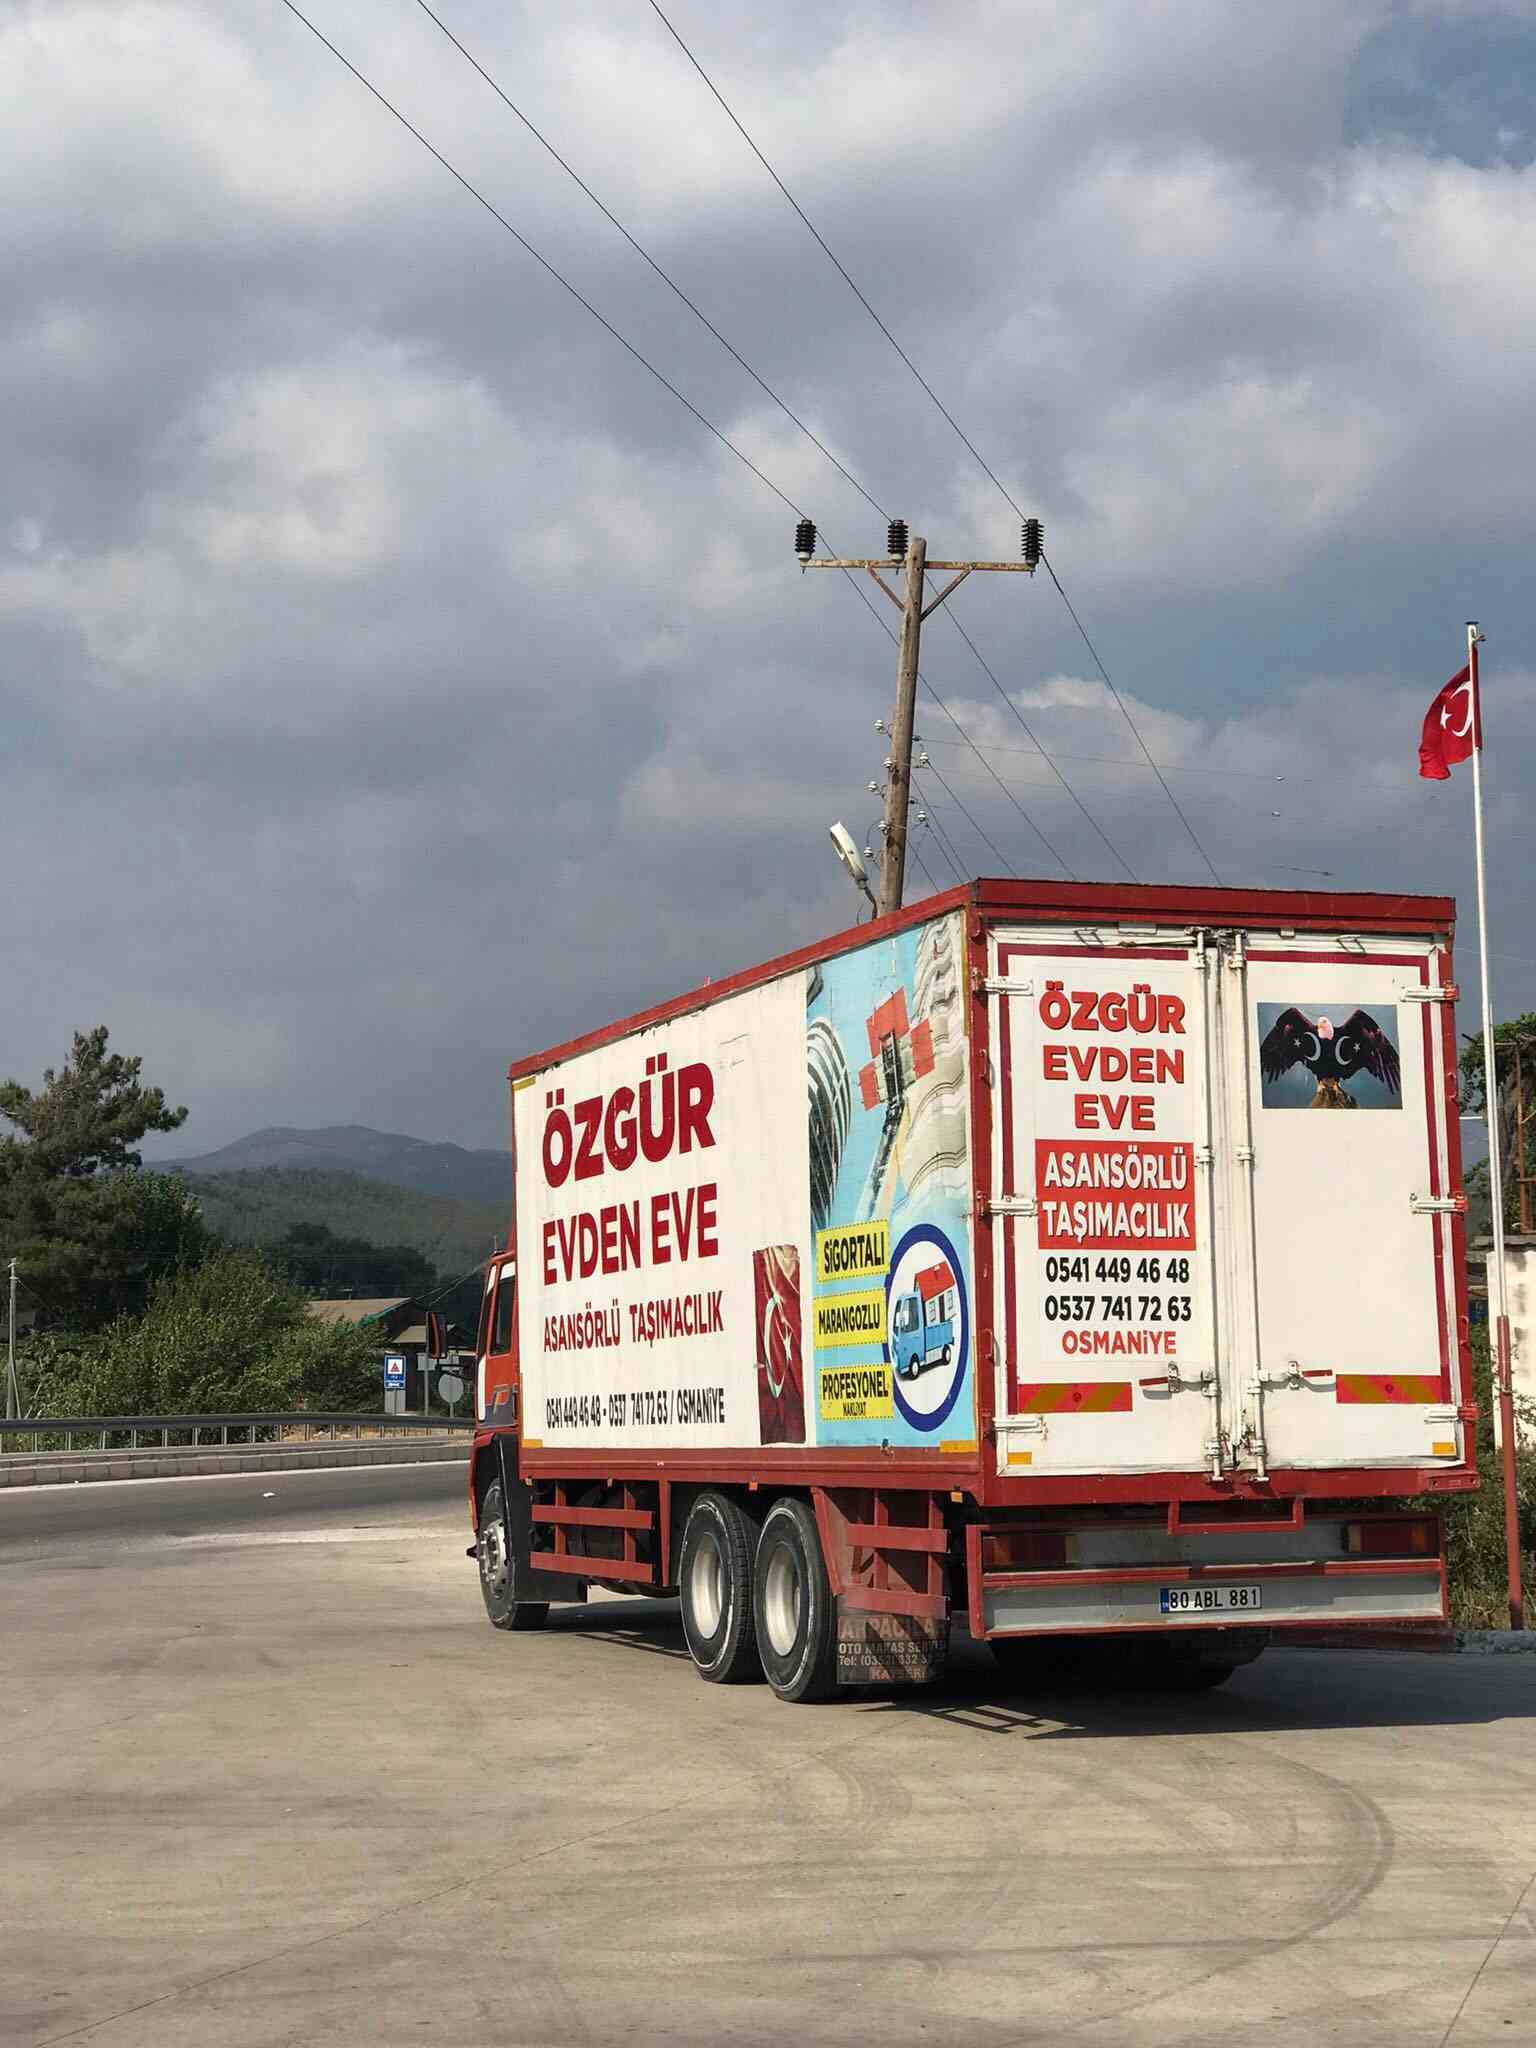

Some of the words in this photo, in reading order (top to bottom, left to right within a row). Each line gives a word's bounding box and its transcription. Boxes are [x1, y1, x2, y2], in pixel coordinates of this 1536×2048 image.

[1039, 980, 1186, 1034] ÖZGÜR
[1043, 1045, 1185, 1084] EVDEN
[542, 1052, 716, 1188] ÖZGÜR
[1074, 1093, 1156, 1130] EVE
[1044, 1145, 1188, 1190] ASANSÖRLÜ
[543, 1200, 641, 1286] EVDEN
[651, 1183, 718, 1265] EVE
[1042, 1200, 1190, 1244] TAŞIMACILIK
[1046, 1256, 1090, 1282] 0541
[1095, 1257, 1131, 1283] 449
[1137, 1258, 1160, 1283] 46
[1166, 1258, 1190, 1283] 48
[544, 1297, 620, 1352] ASANSÖRLÜ
[629, 1290, 724, 1348] TAŞIMACILIK
[818, 1303, 880, 1335] MARANGOZLU
[1045, 1295, 1095, 1321] 0537
[1101, 1296, 1132, 1321] 741
[1138, 1296, 1162, 1321] 72
[1167, 1296, 1192, 1321] 63
[822, 1371, 889, 1400] PROFESYONEL
[546, 1398, 563, 1429] 0541
[564, 1397, 578, 1428] 449
[579, 1395, 589, 1427] 46
[590, 1395, 601, 1427] 48
[609, 1394, 626, 1427] 0537
[631, 1391, 644, 1425] 741
[645, 1391, 656, 1425] 72
[657, 1390, 668, 1424] 63
[1170, 1591, 1189, 1609] 80
[1194, 1590, 1223, 1608] ABL
[1229, 1589, 1257, 1606] 881
[839, 1642, 862, 1654] OTO
